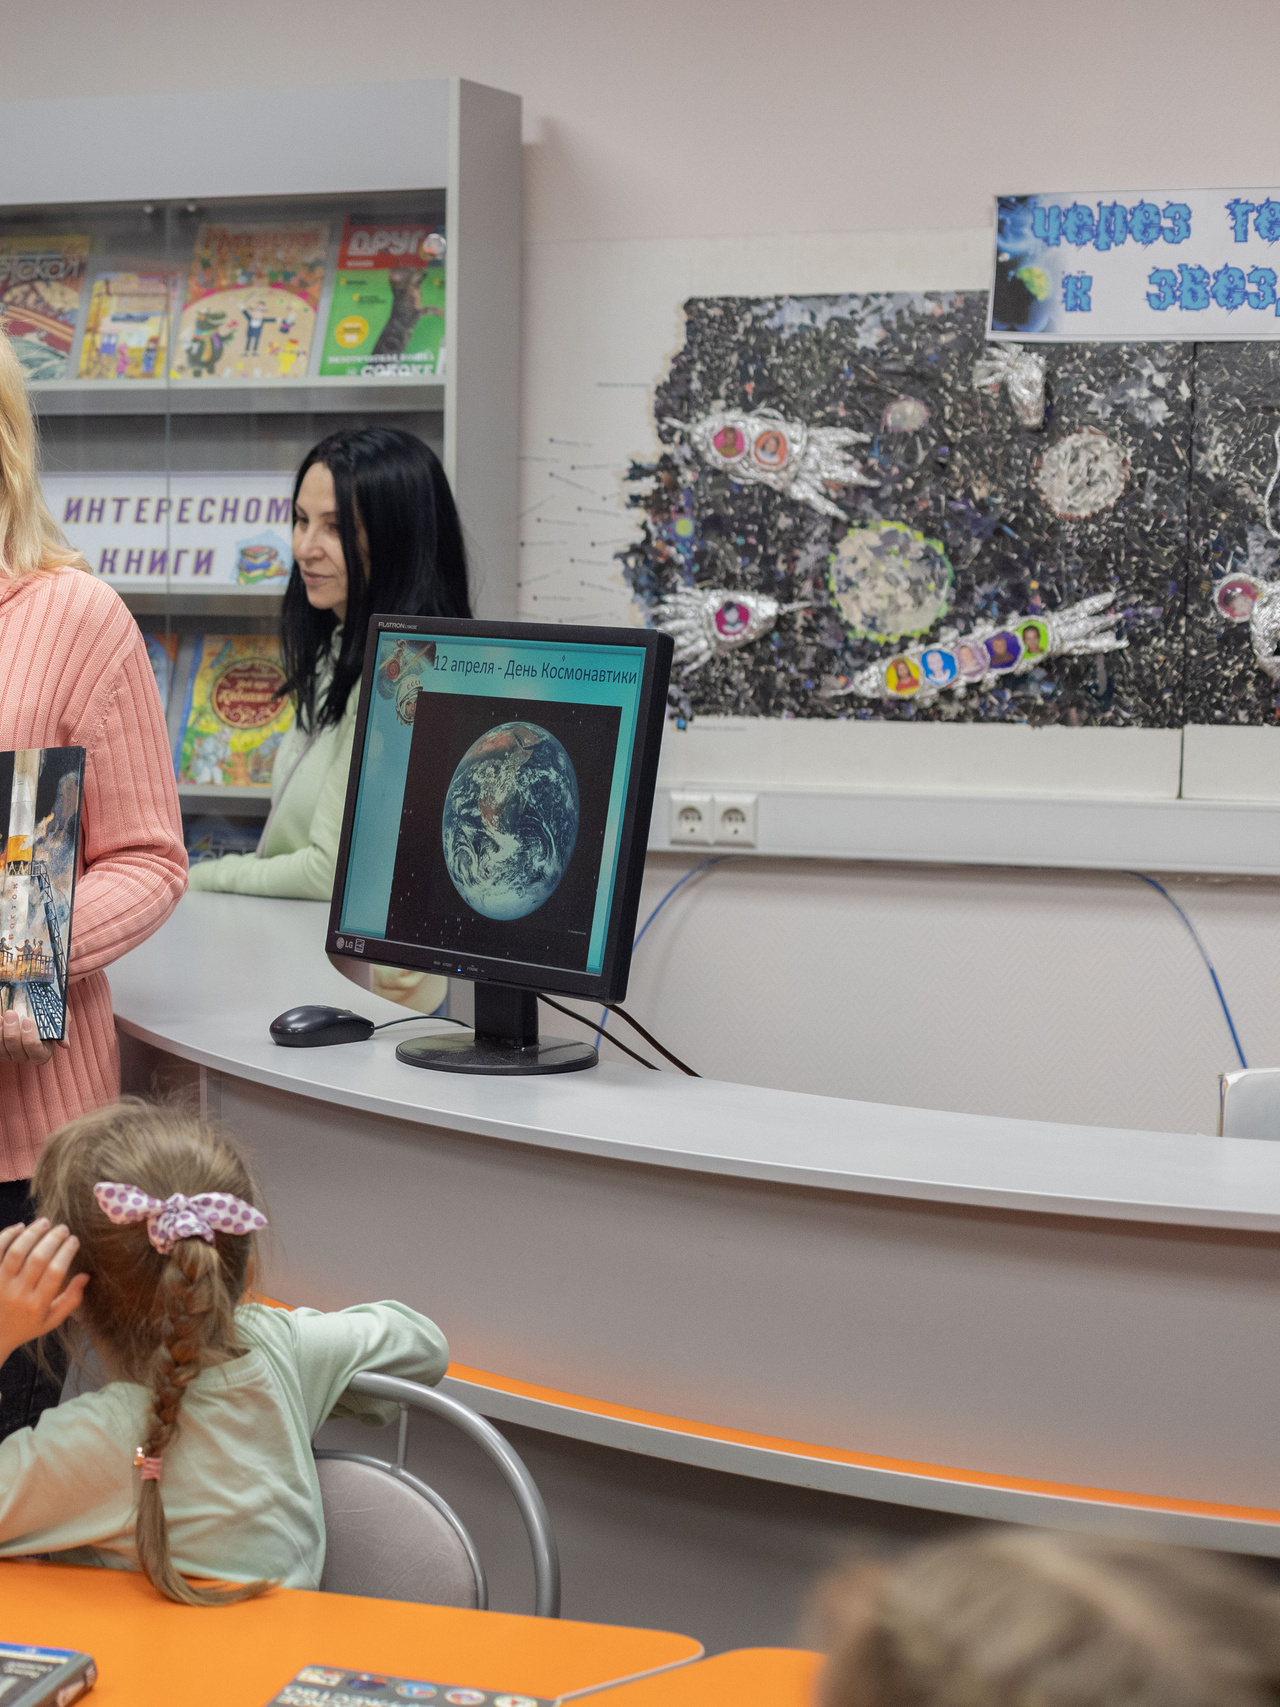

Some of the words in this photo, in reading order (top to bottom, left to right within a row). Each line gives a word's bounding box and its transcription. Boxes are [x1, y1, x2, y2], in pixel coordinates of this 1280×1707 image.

[98, 548, 216, 576] КНИГИ
[434, 655, 448, 672] 12
[450, 660, 495, 676] апреля
[504, 660, 538, 679] День
[541, 662, 637, 685] Космонавтики
